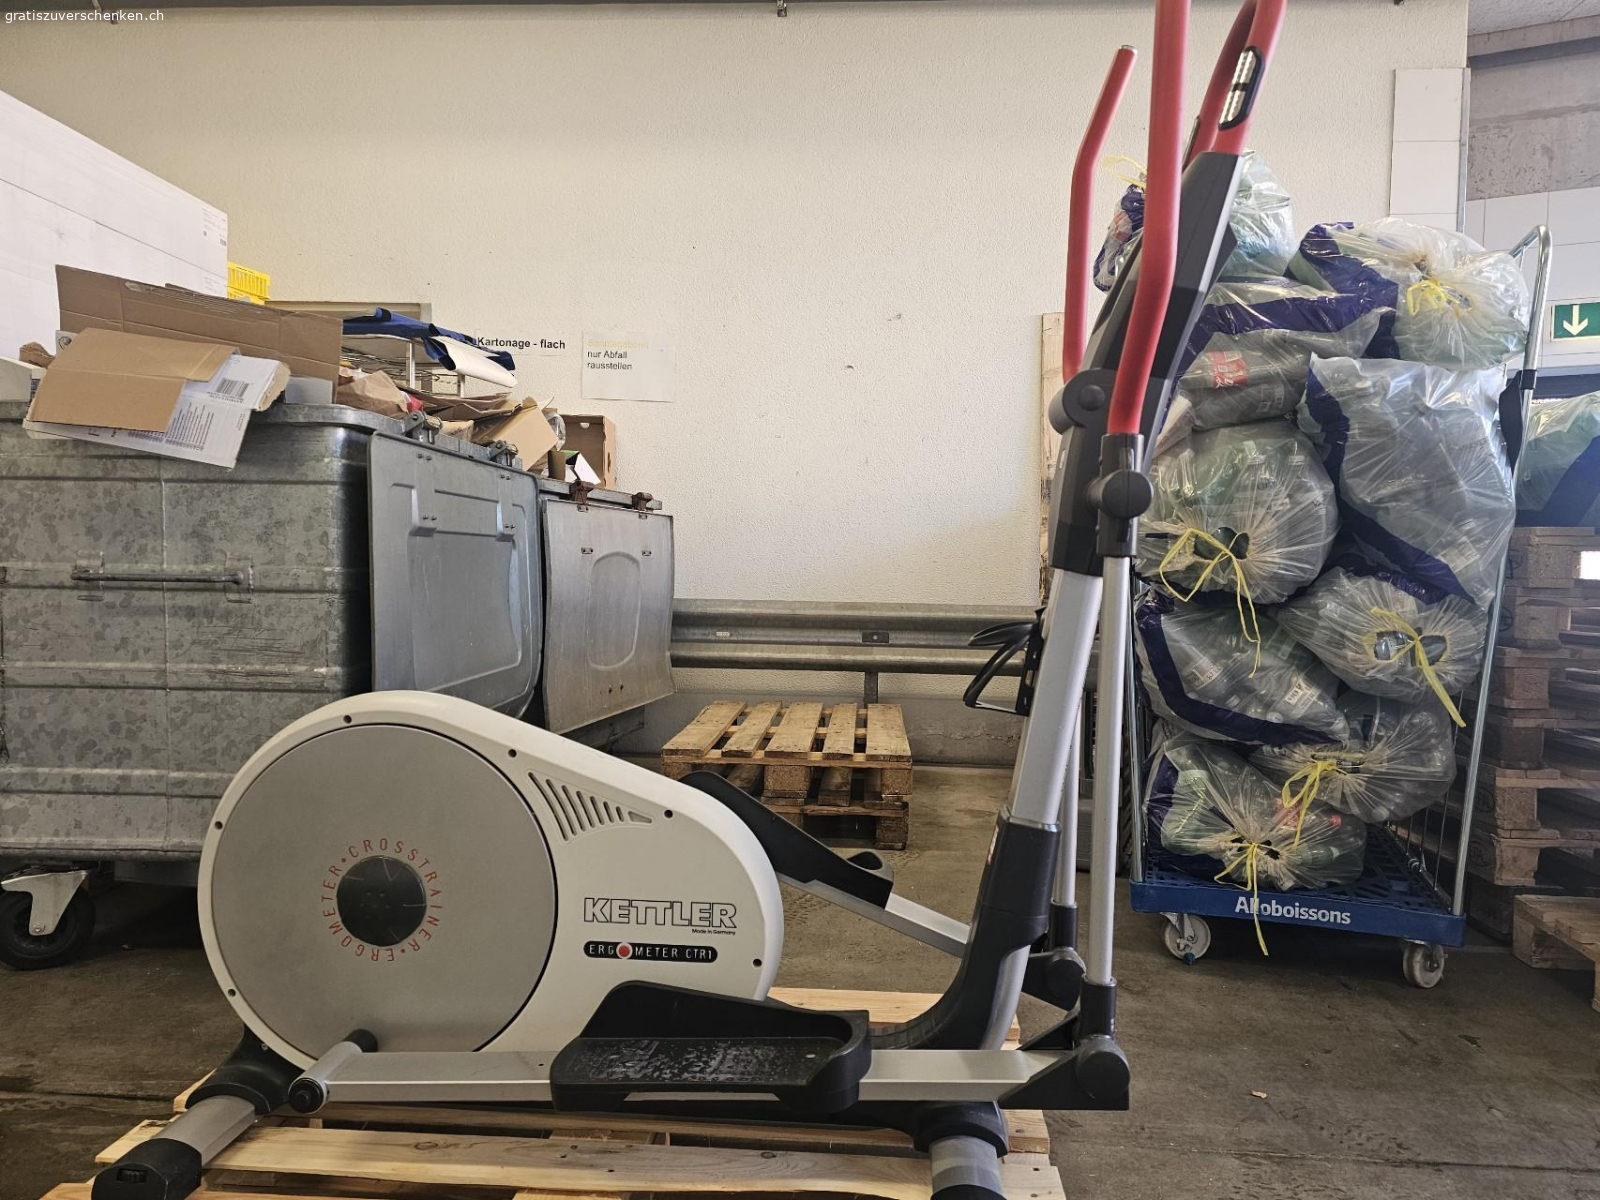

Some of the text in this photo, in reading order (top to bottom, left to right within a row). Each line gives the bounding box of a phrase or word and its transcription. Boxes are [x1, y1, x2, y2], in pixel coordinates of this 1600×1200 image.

[477, 337, 531, 349] Kartonage
[540, 339, 566, 349] flach
[587, 350, 628, 359] nur Abfall
[587, 361, 633, 371] rausstellen
[348, 838, 443, 952] CROSSTRAINER
[321, 864, 395, 962] ERGOMETER
[584, 897, 737, 928] KETTLER
[1235, 896, 1351, 925] Alloboissons
[685, 948, 713, 960] CTR1
